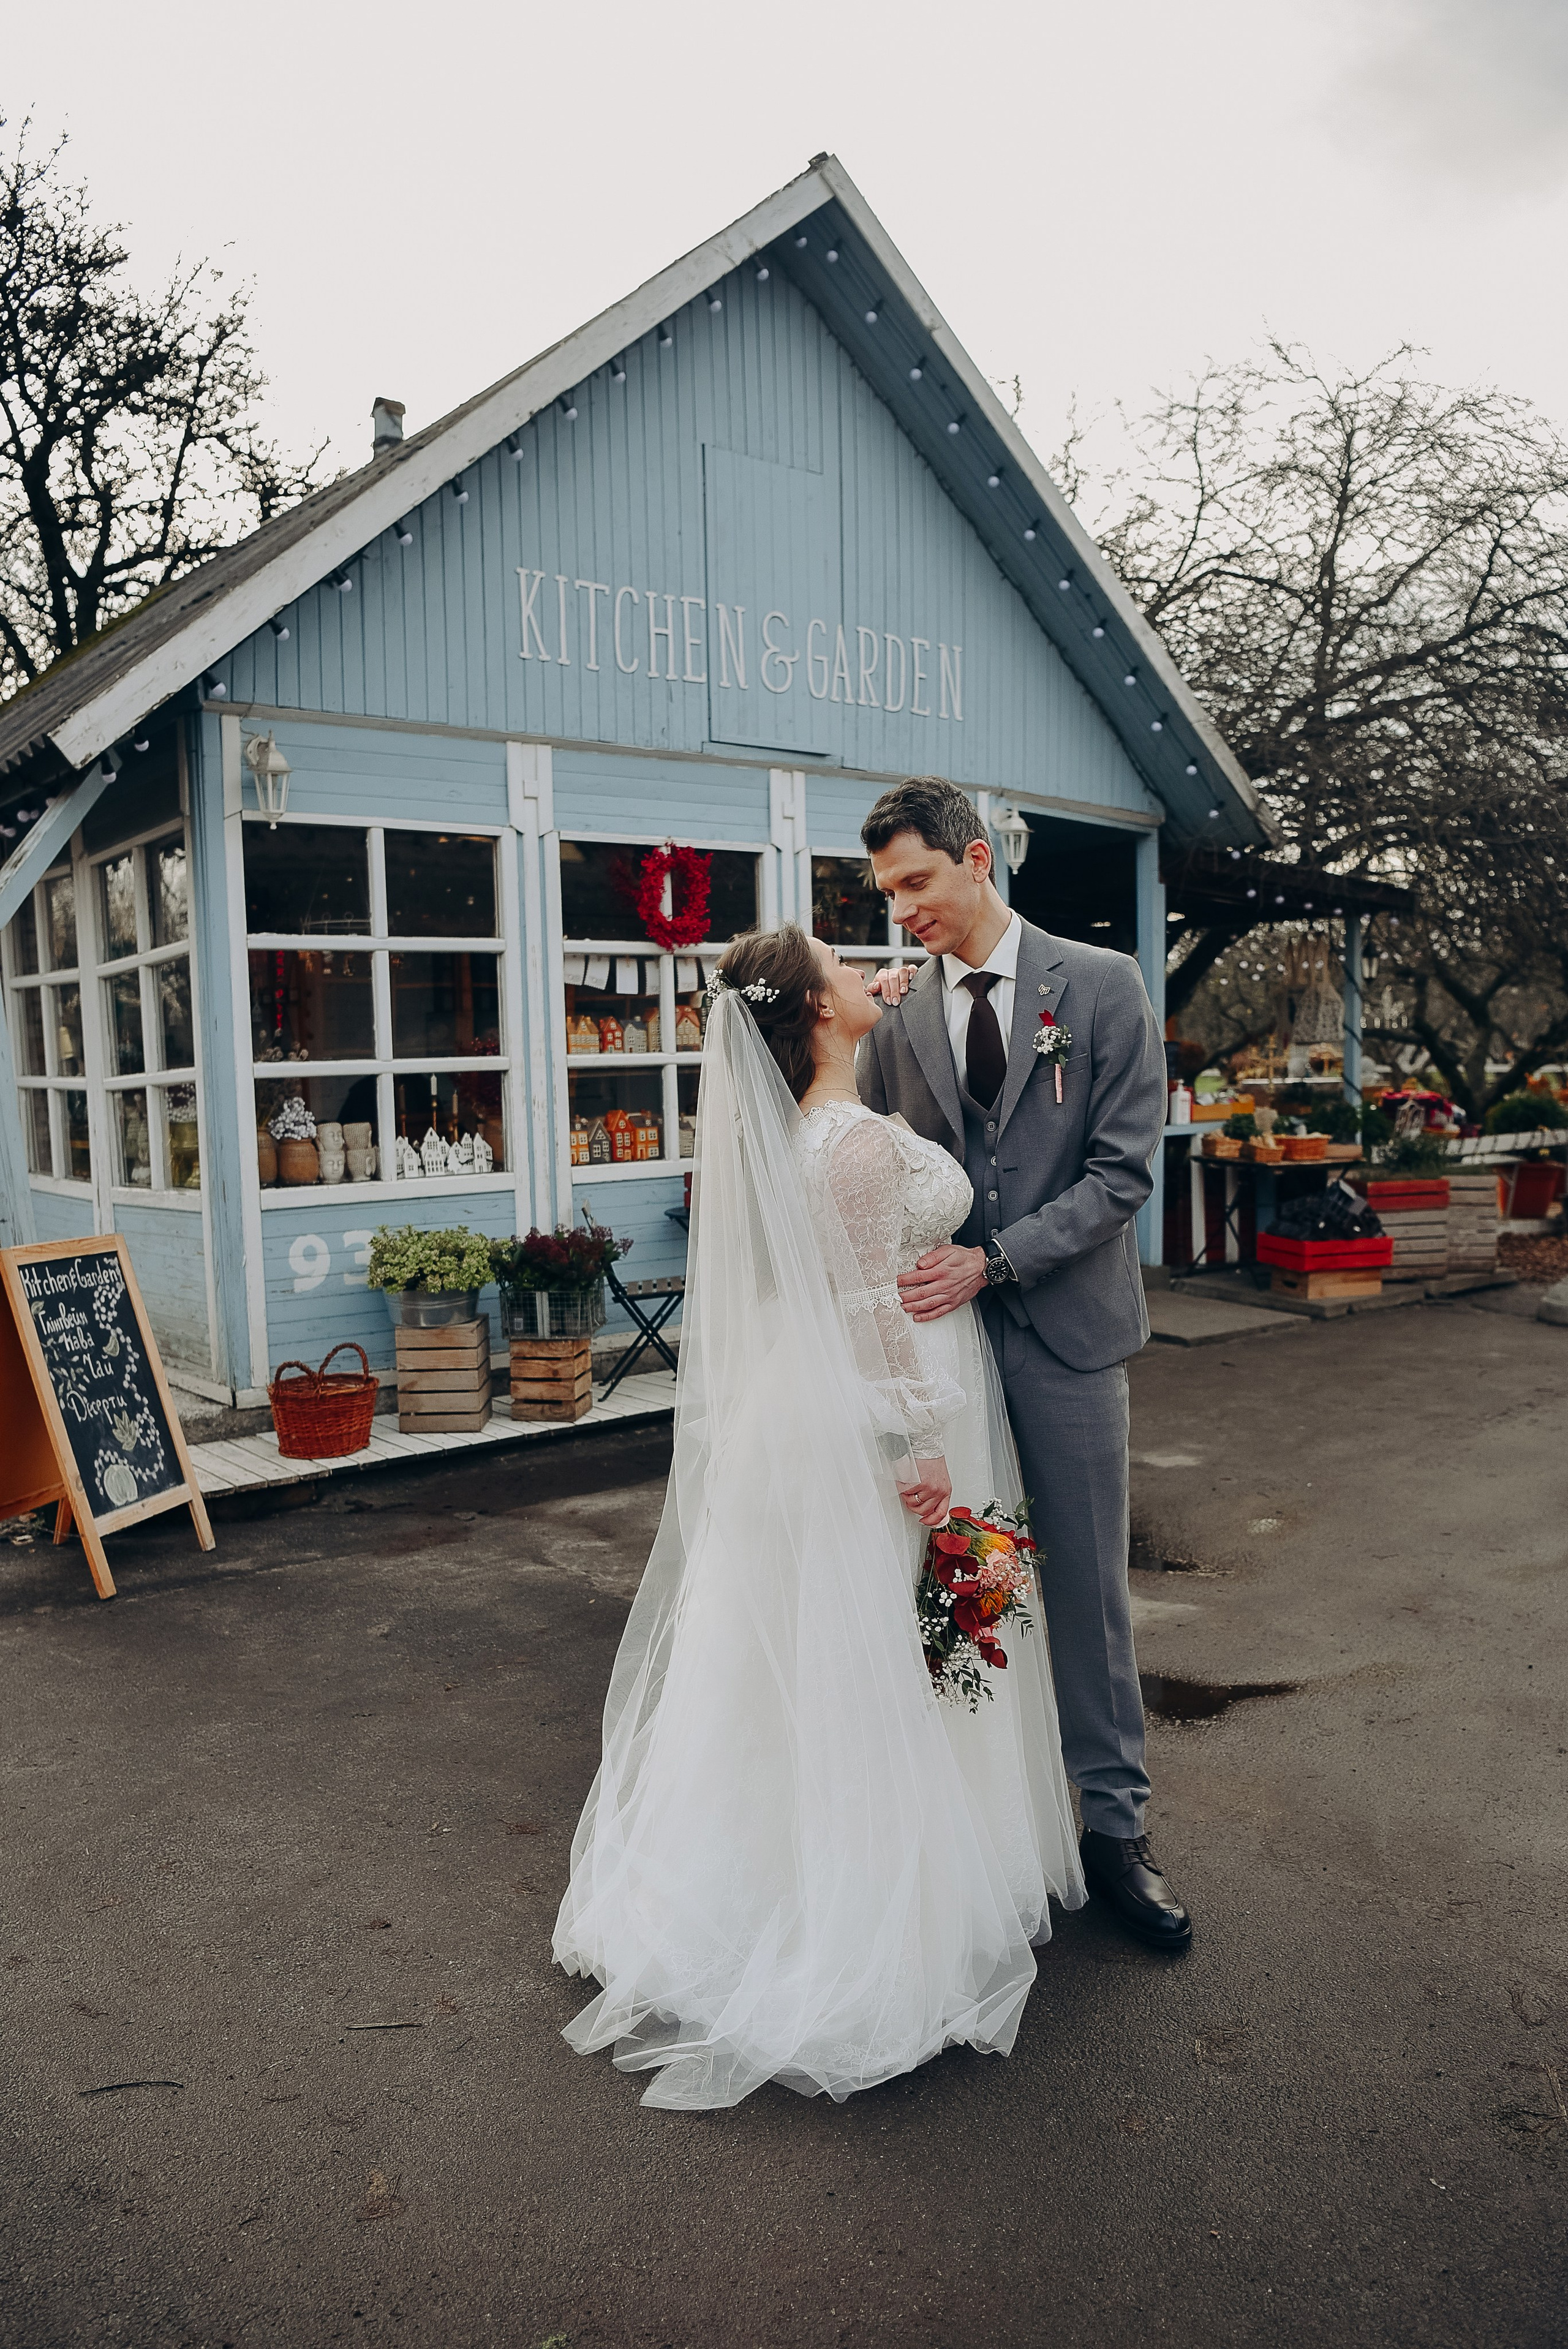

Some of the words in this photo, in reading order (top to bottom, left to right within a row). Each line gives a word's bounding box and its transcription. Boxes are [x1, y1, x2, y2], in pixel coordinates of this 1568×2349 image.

[516, 567, 748, 690] KITCHEN
[806, 619, 963, 721] GARDEN
[83, 1352, 115, 1379] Чай
